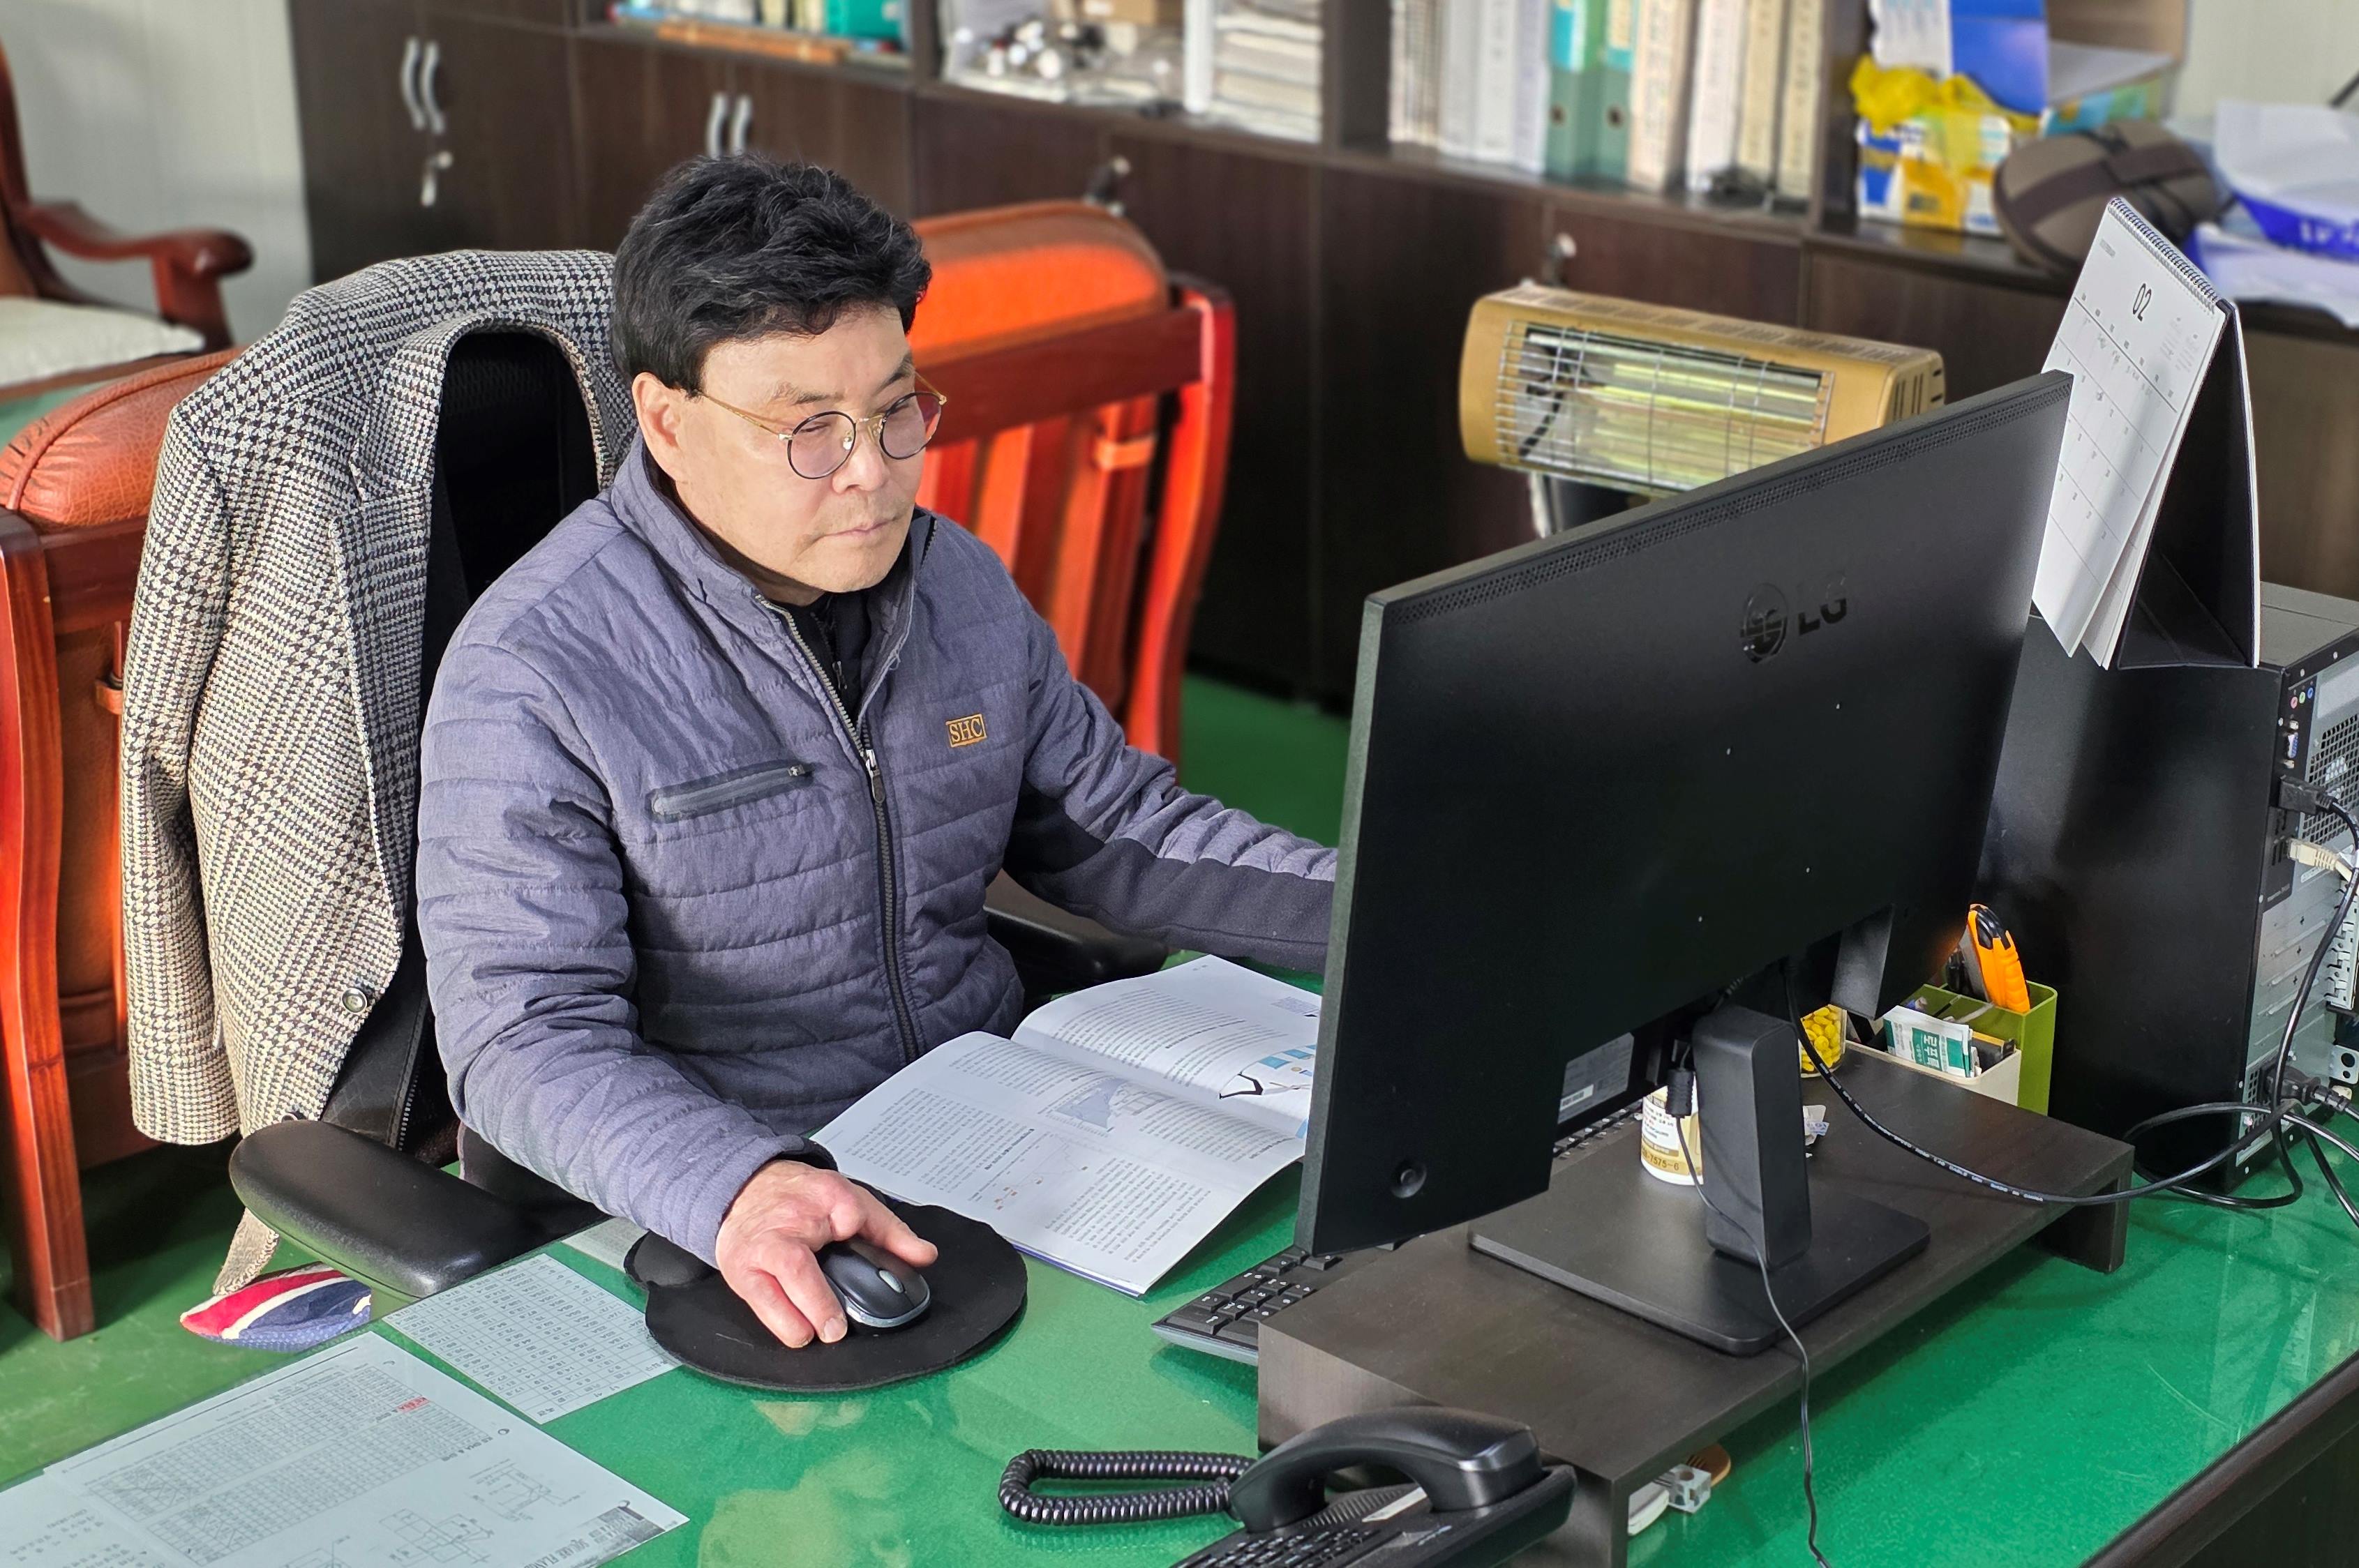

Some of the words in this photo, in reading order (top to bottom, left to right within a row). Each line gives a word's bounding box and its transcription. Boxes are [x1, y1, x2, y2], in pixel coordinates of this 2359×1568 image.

[2132, 282, 2152, 322] 02
[949, 718, 983, 742] SHC
[523, 1553, 559, 1568] FLAN
